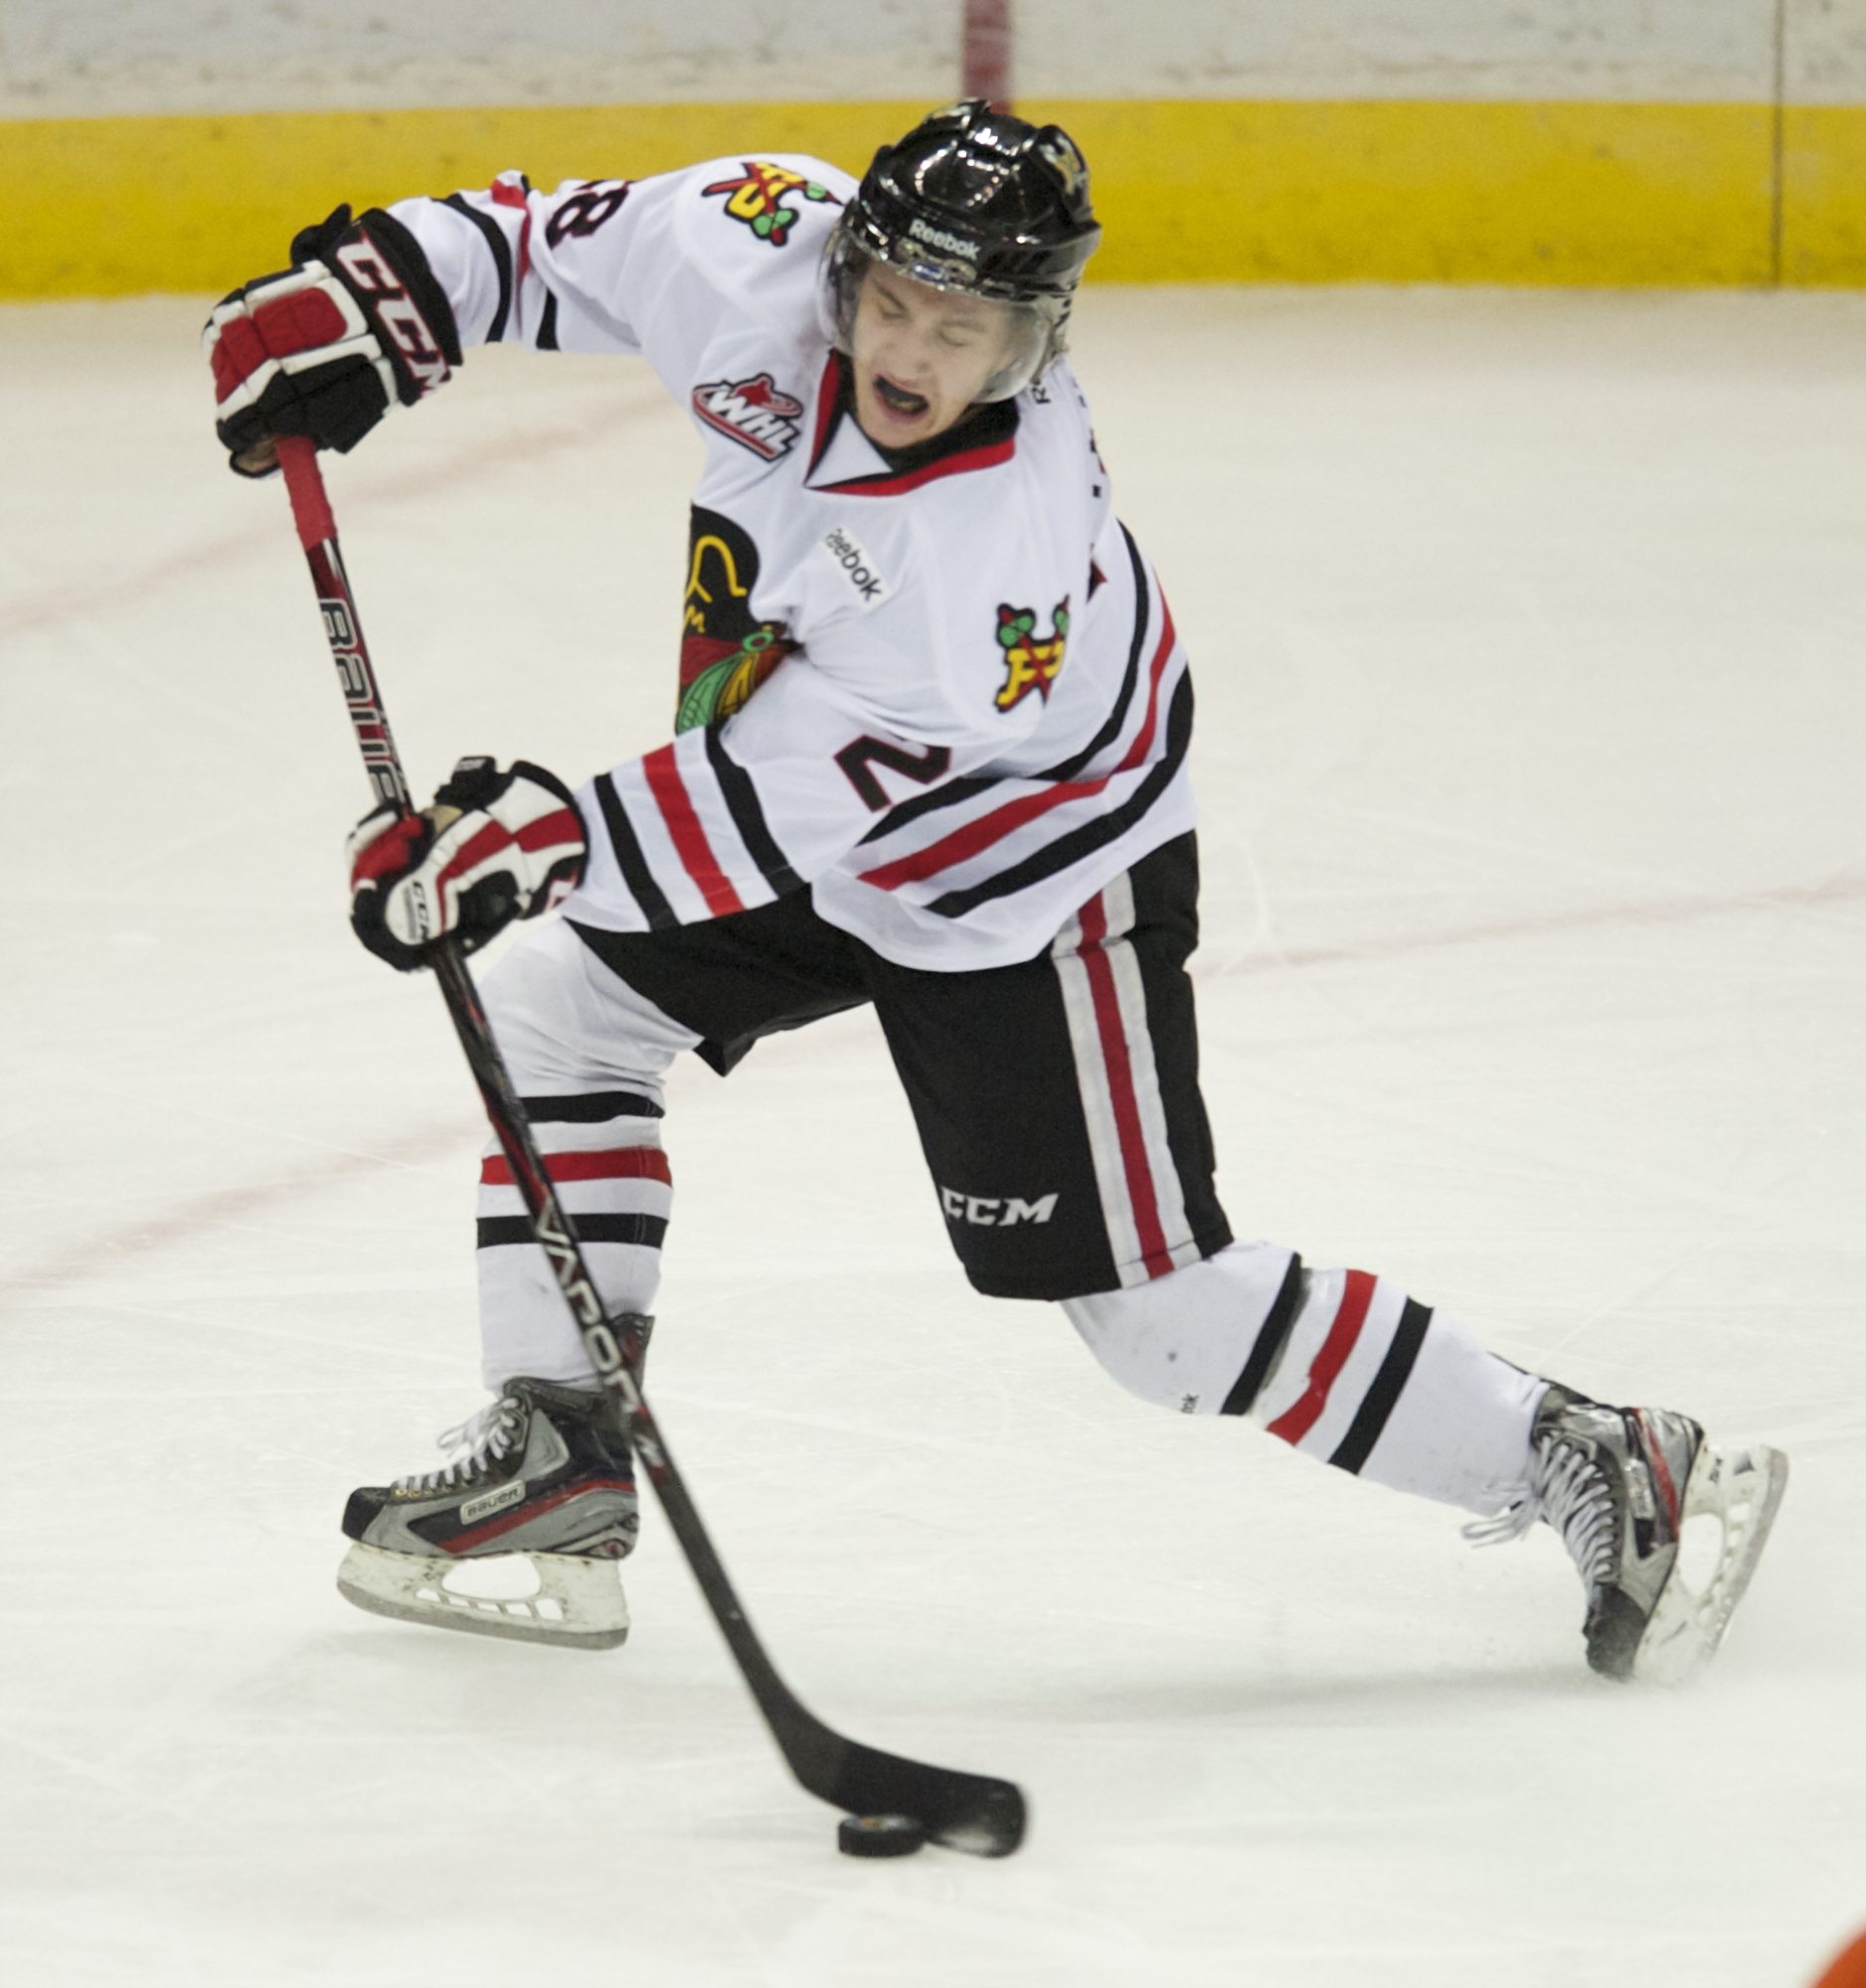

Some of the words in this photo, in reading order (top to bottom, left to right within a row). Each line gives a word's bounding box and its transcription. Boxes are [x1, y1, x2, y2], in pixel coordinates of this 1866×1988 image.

[544, 179, 634, 250] 8
[909, 218, 981, 260] Reebok
[707, 386, 795, 456] WHL
[317, 598, 406, 805] BAUE
[940, 1186, 1059, 1227] CCM
